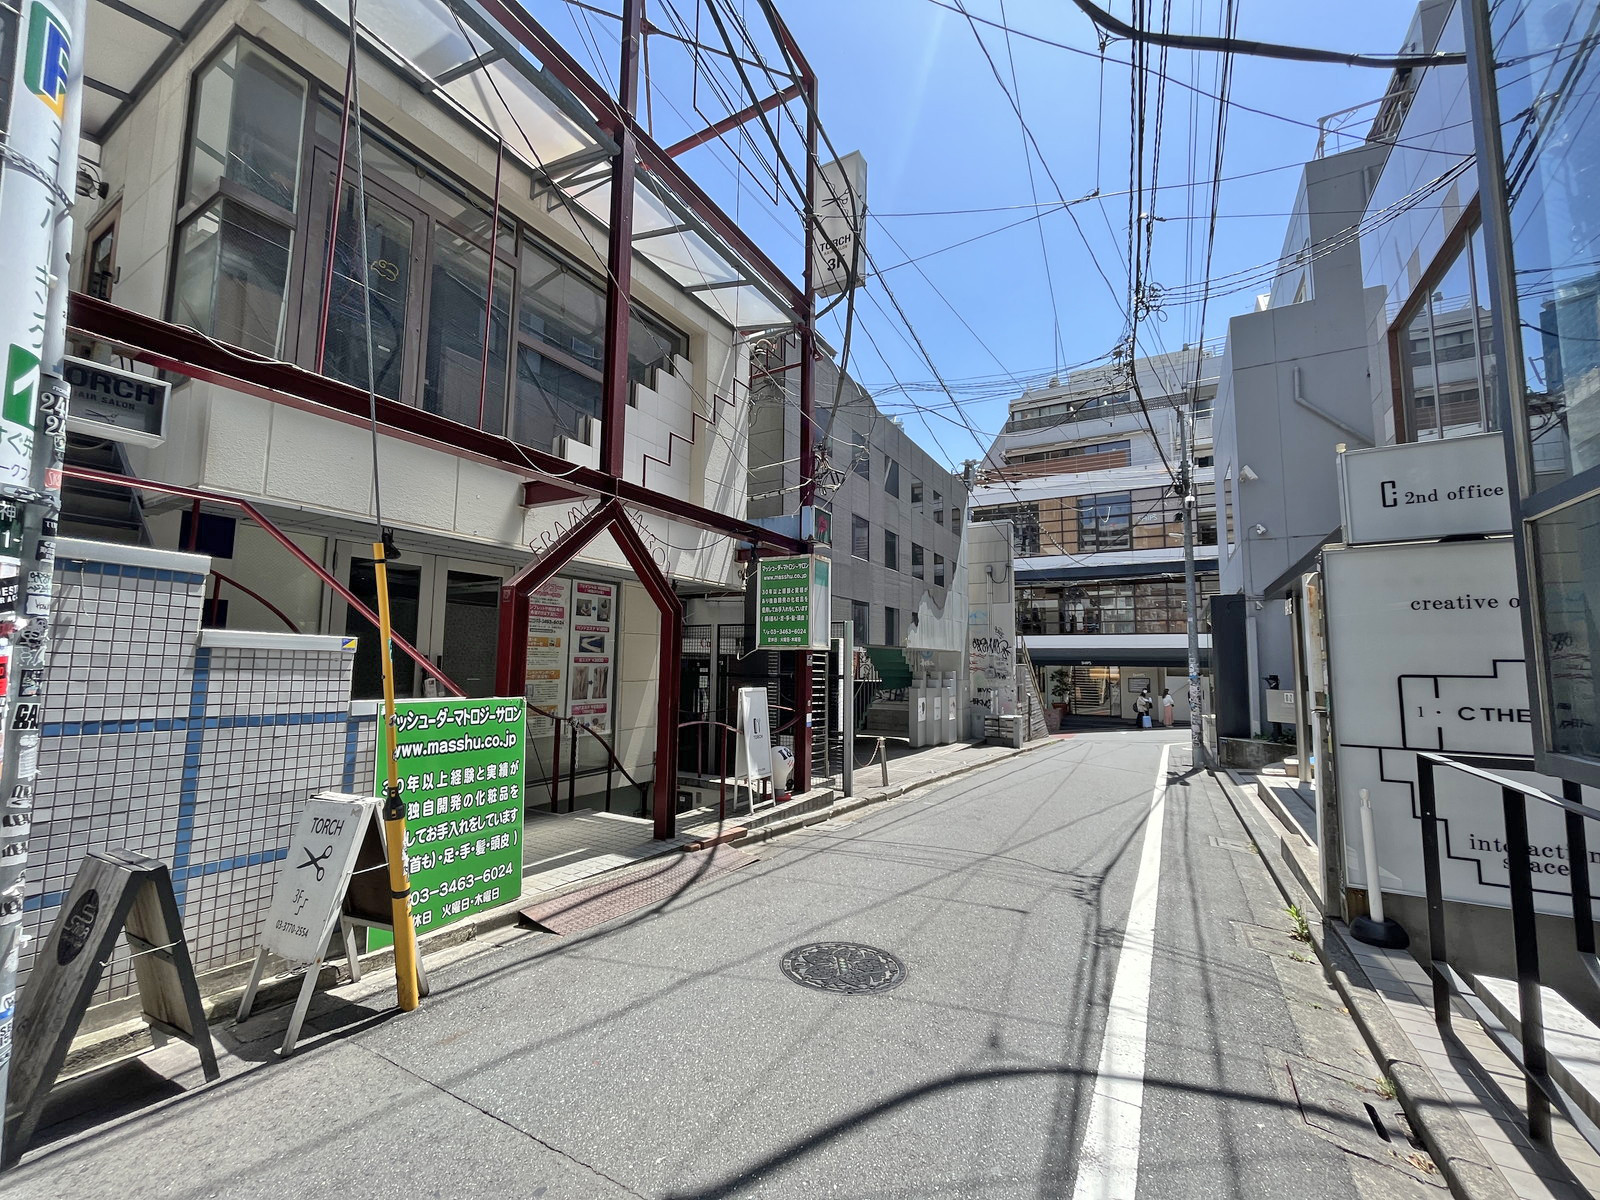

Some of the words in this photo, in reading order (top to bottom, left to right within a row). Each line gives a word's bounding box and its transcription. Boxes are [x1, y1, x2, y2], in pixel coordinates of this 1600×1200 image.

[65, 366, 157, 405] ORCH
[101, 396, 136, 411] SALON
[1405, 488, 1438, 505] 2nd
[1447, 484, 1504, 501] office
[1410, 594, 1499, 611] creative
[1508, 597, 1520, 609] o
[396, 706, 522, 733] ッシューダーマトロジーサロン
[407, 784, 520, 821] 独自開発の化粧品を
[310, 817, 345, 836] TORCH
[405, 807, 519, 848] してお手入れをしています
[1503, 857, 1571, 877] sace
[292, 888, 305, 904] 3F
[275, 919, 310, 938] 03-3770-2554
[412, 910, 433, 929] 休日
